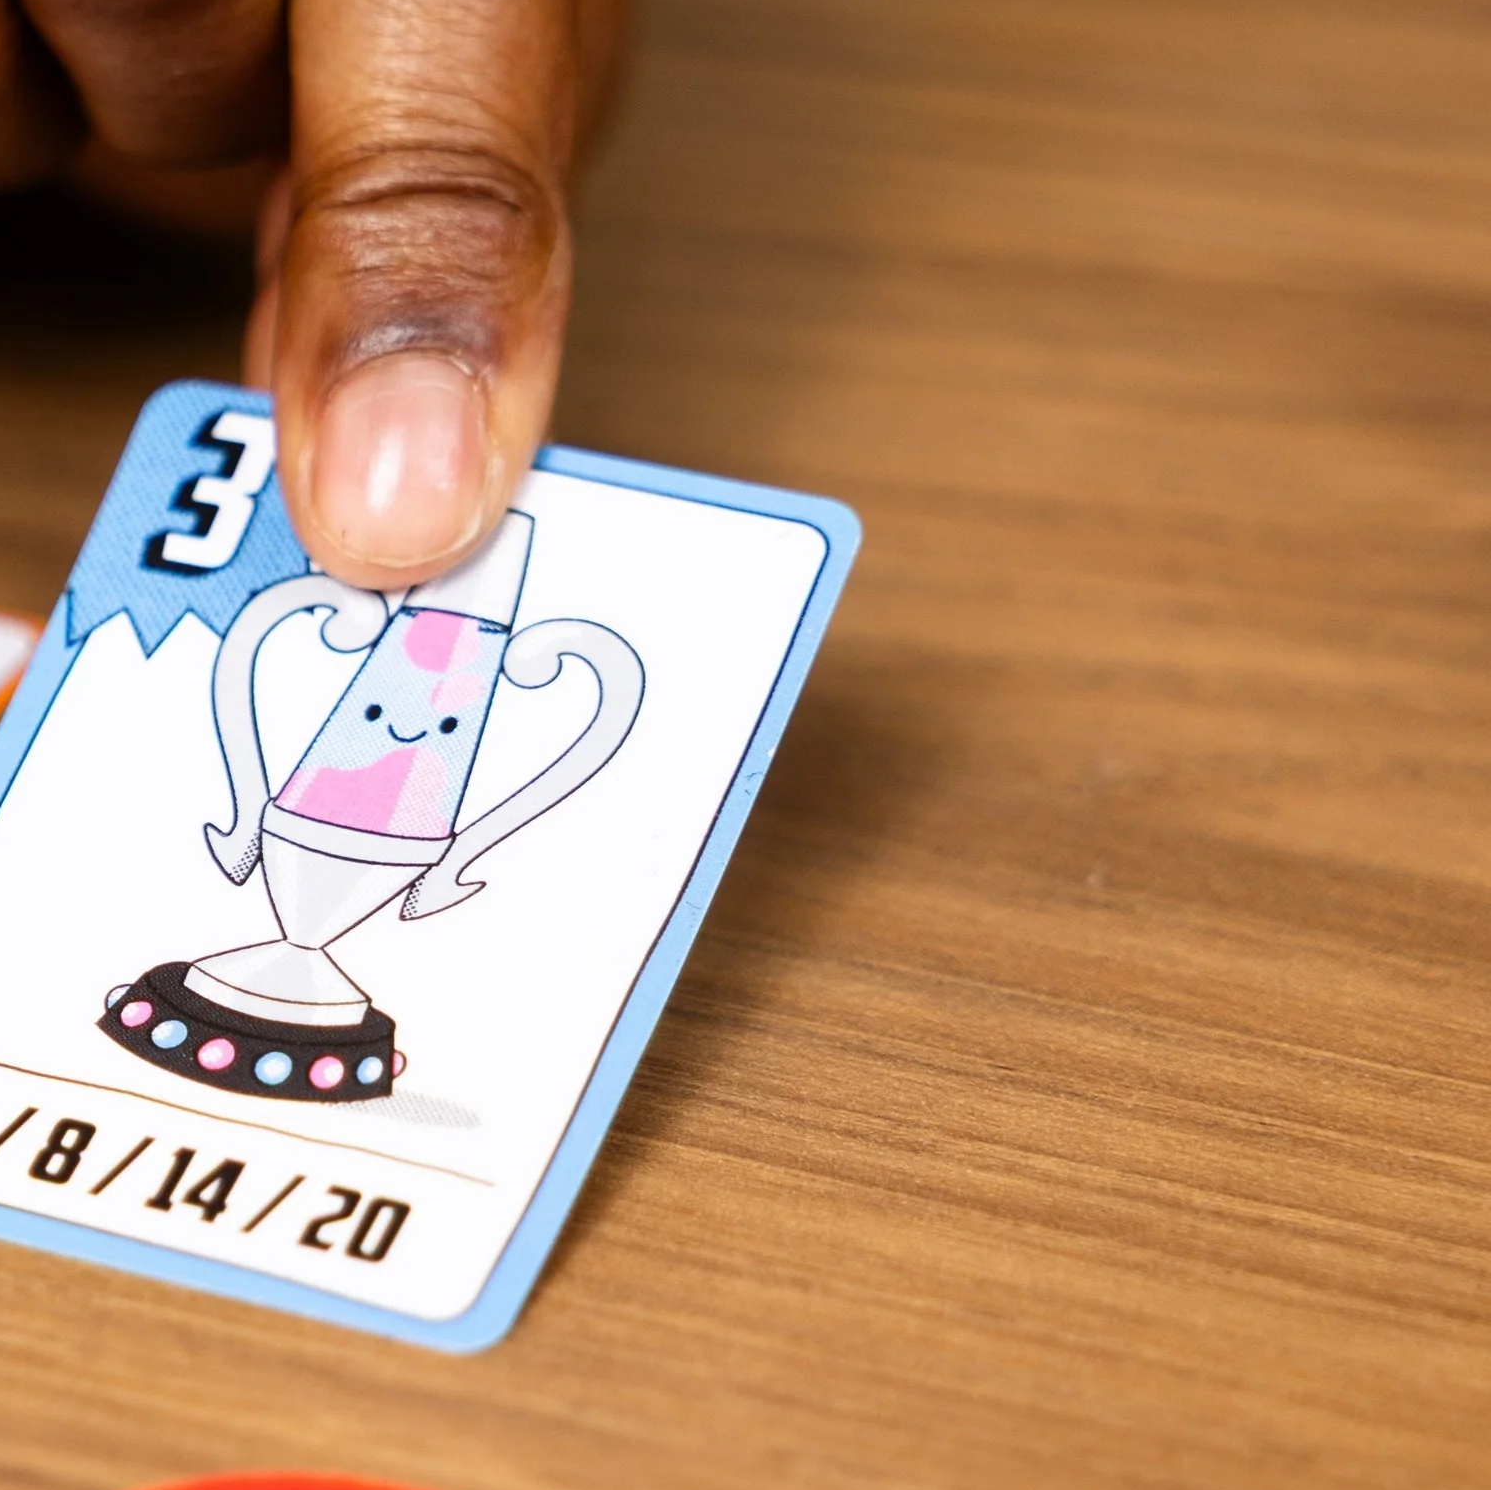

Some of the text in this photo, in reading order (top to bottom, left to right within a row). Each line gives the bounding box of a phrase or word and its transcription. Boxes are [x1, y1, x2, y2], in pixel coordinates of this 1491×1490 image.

[141, 407, 276, 575] 3
[27, 1118, 98, 1185] 8
[143, 1147, 247, 1223] 14
[297, 1185, 412, 1263] 20
